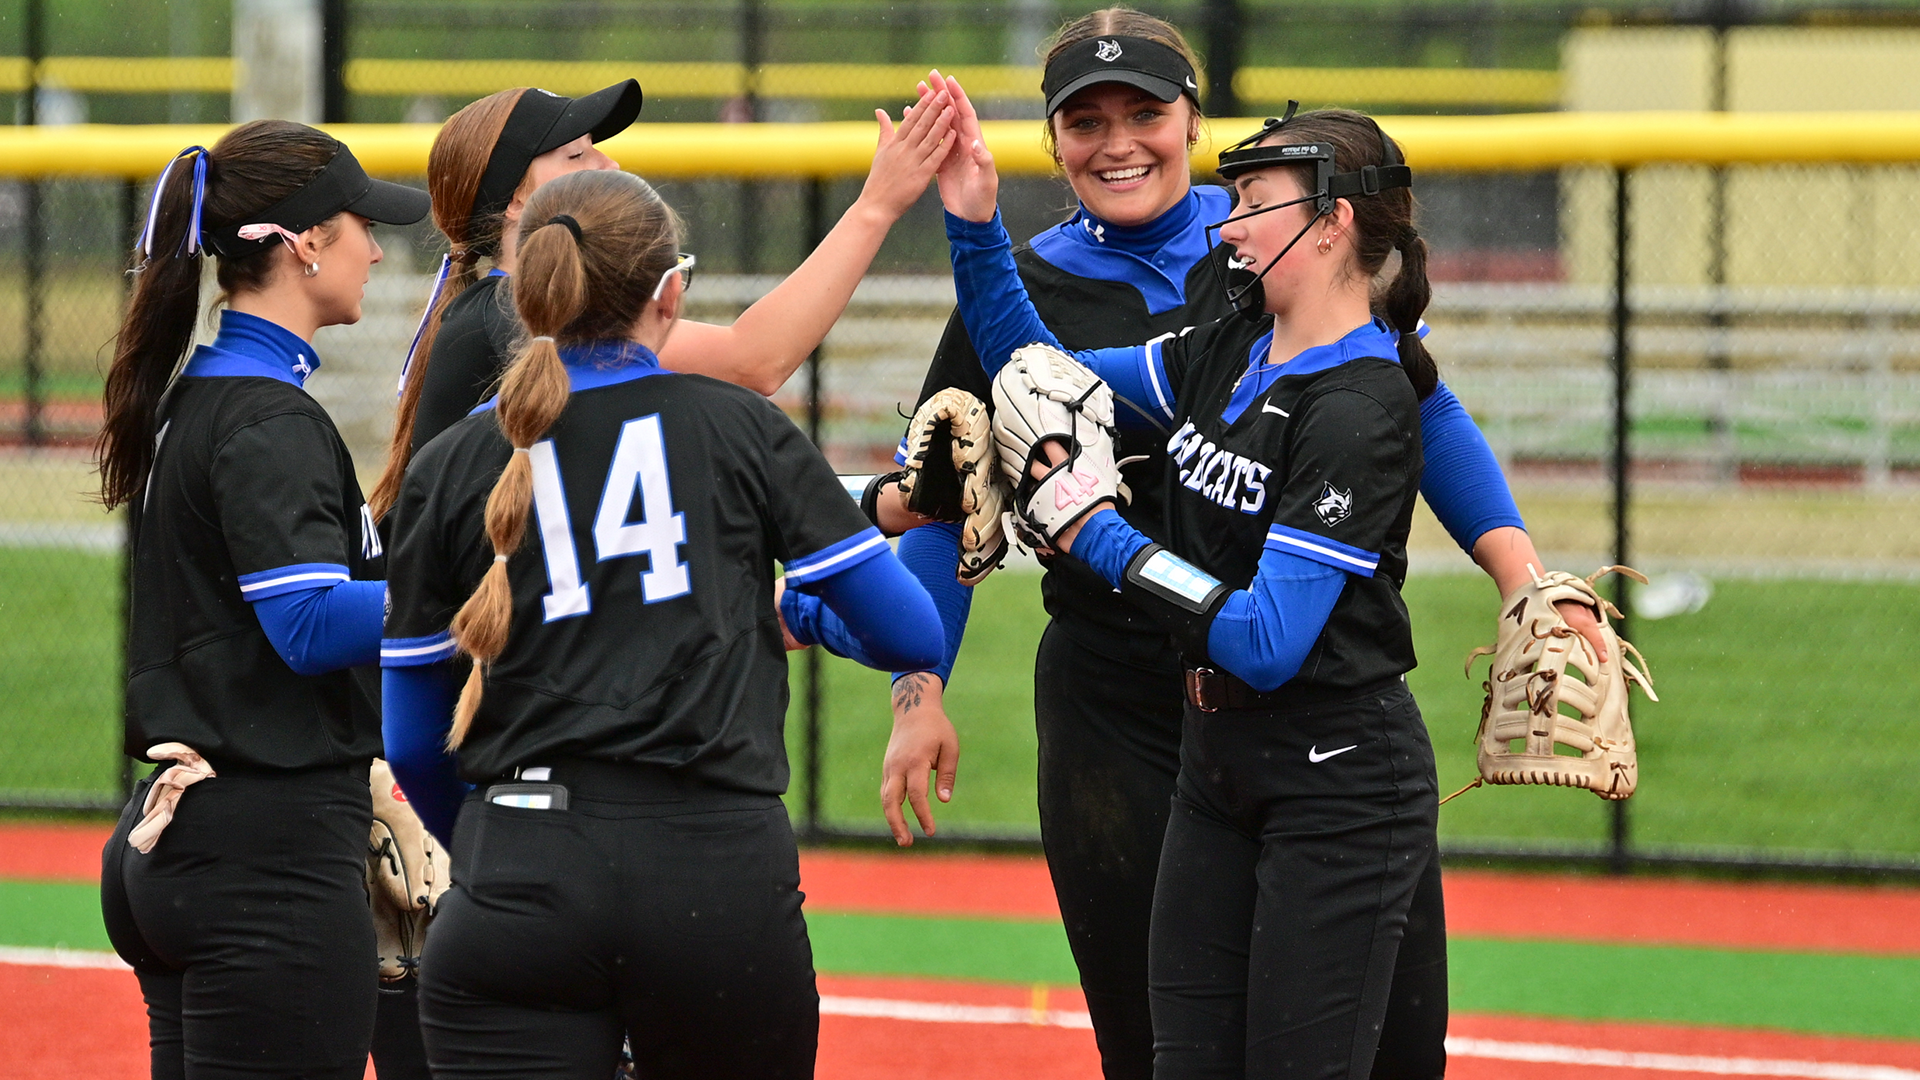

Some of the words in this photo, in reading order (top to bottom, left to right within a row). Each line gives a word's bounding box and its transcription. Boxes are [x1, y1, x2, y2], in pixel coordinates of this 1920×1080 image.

[1055, 469, 1099, 511] 44
[1167, 416, 1273, 515] WLDCATS
[529, 411, 692, 625] 14
